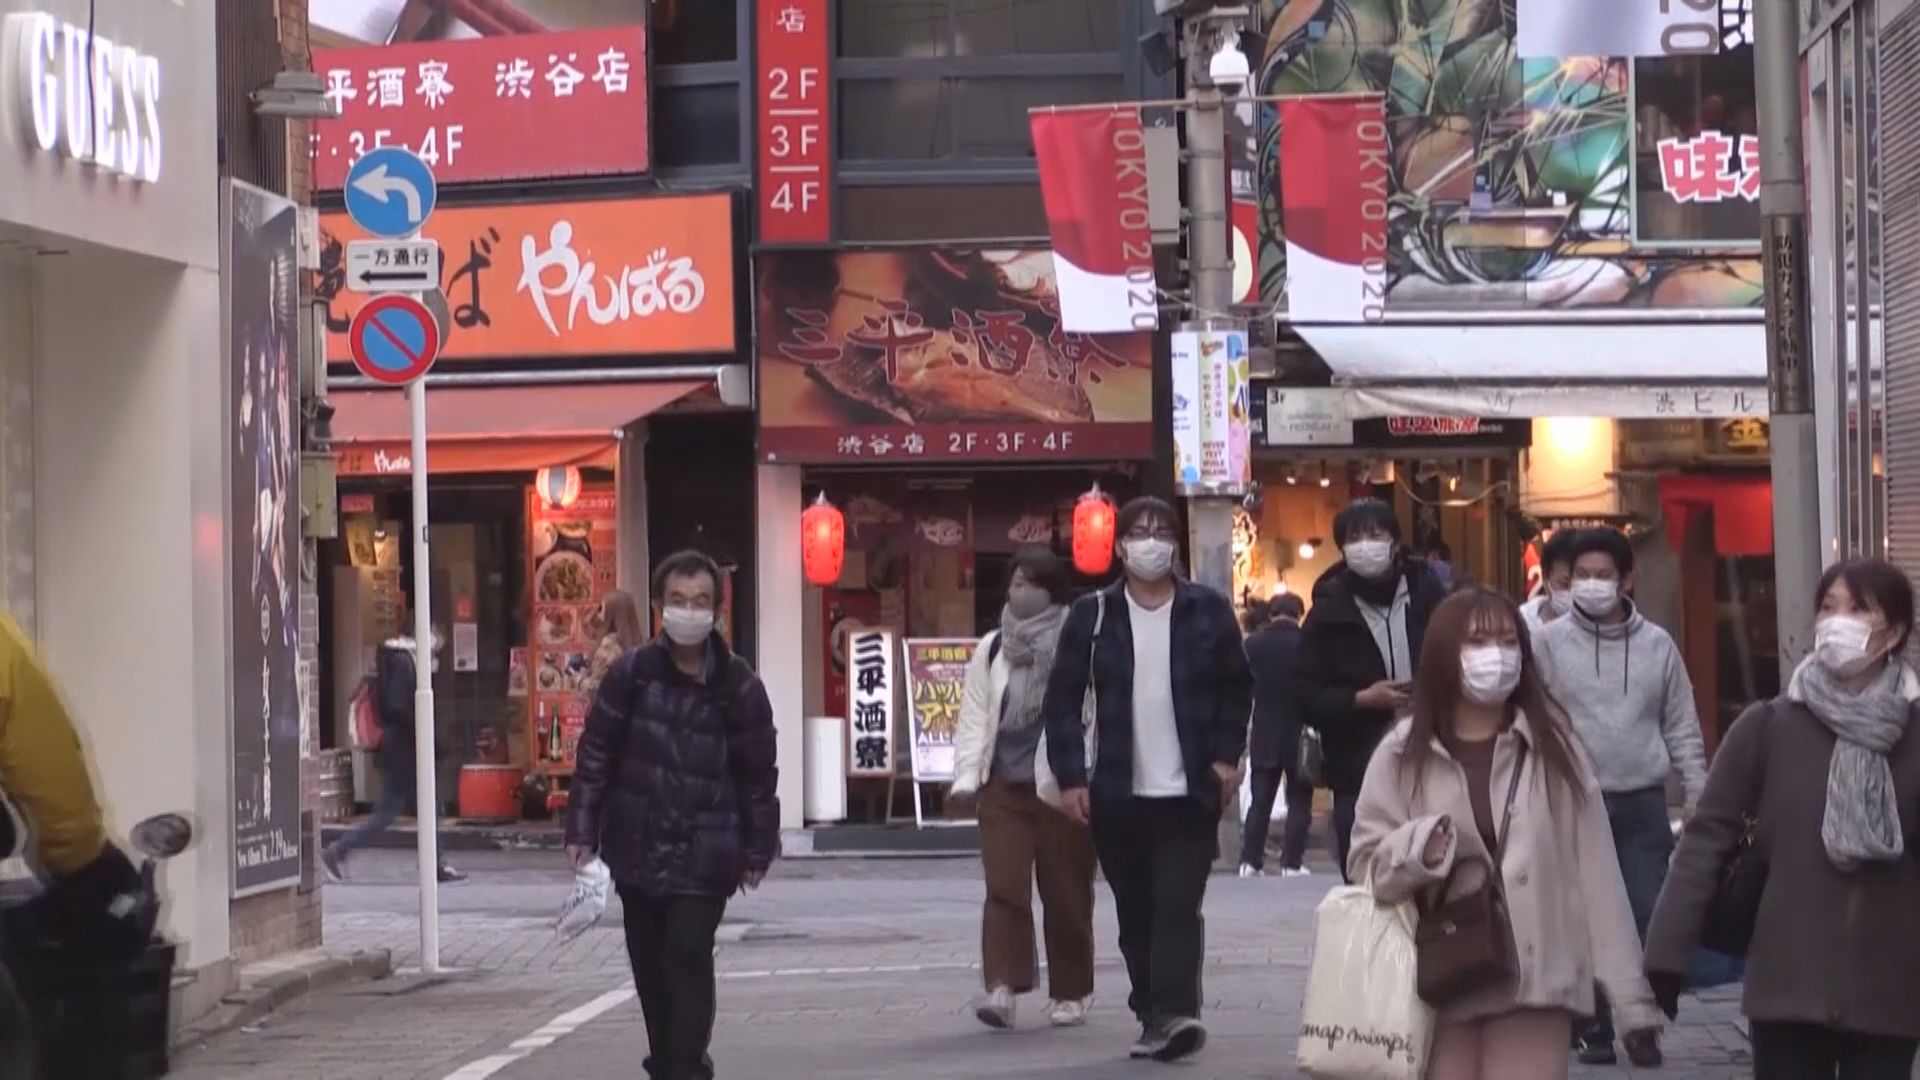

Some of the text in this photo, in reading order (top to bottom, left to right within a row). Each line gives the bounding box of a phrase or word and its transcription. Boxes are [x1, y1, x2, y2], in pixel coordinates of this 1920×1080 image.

[30, 11, 161, 183] GUESS
[495, 46, 630, 97] 渋谷店
[768, 68, 819, 100] 2F
[770, 125, 819, 157] 3F
[1657, 130, 1760, 203] 味
[770, 181, 820, 213] 4F
[1109, 104, 1160, 331] TOKYO 2020
[1355, 100, 1389, 323] TOKYO 2020
[354, 248, 430, 266] 一方通行
[516, 219, 705, 337] やんばる
[837, 432, 926, 455] 渋谷店
